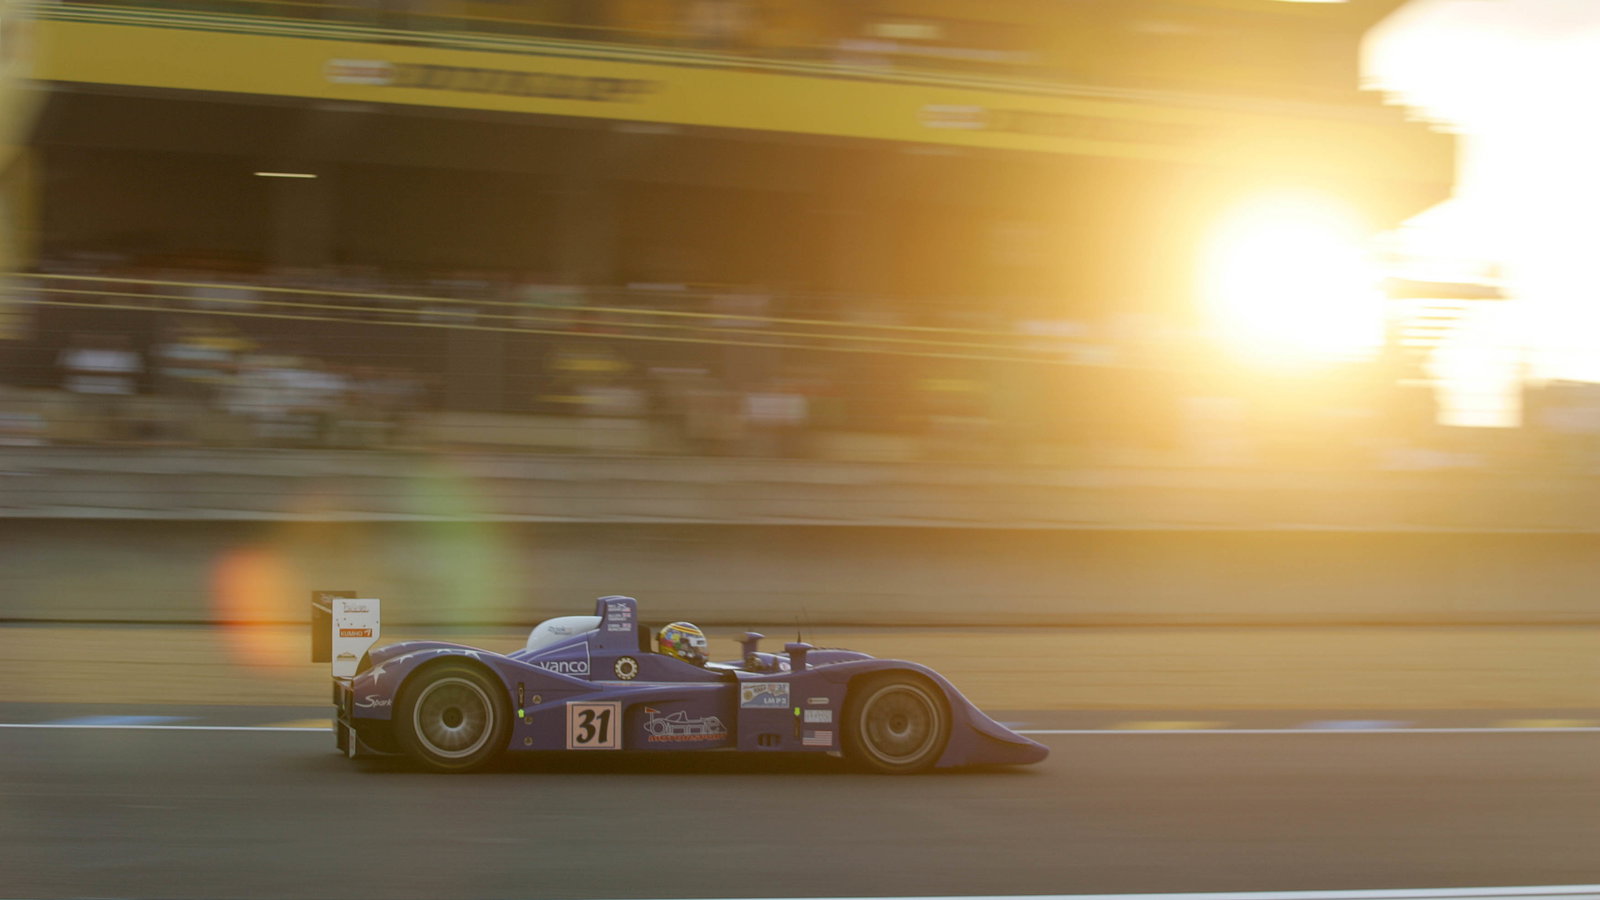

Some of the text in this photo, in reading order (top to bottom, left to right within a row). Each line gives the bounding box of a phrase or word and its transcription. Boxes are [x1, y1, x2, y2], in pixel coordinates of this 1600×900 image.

[540, 661, 588, 673] vanco
[355, 694, 392, 708] Spark
[576, 709, 611, 744] 31
